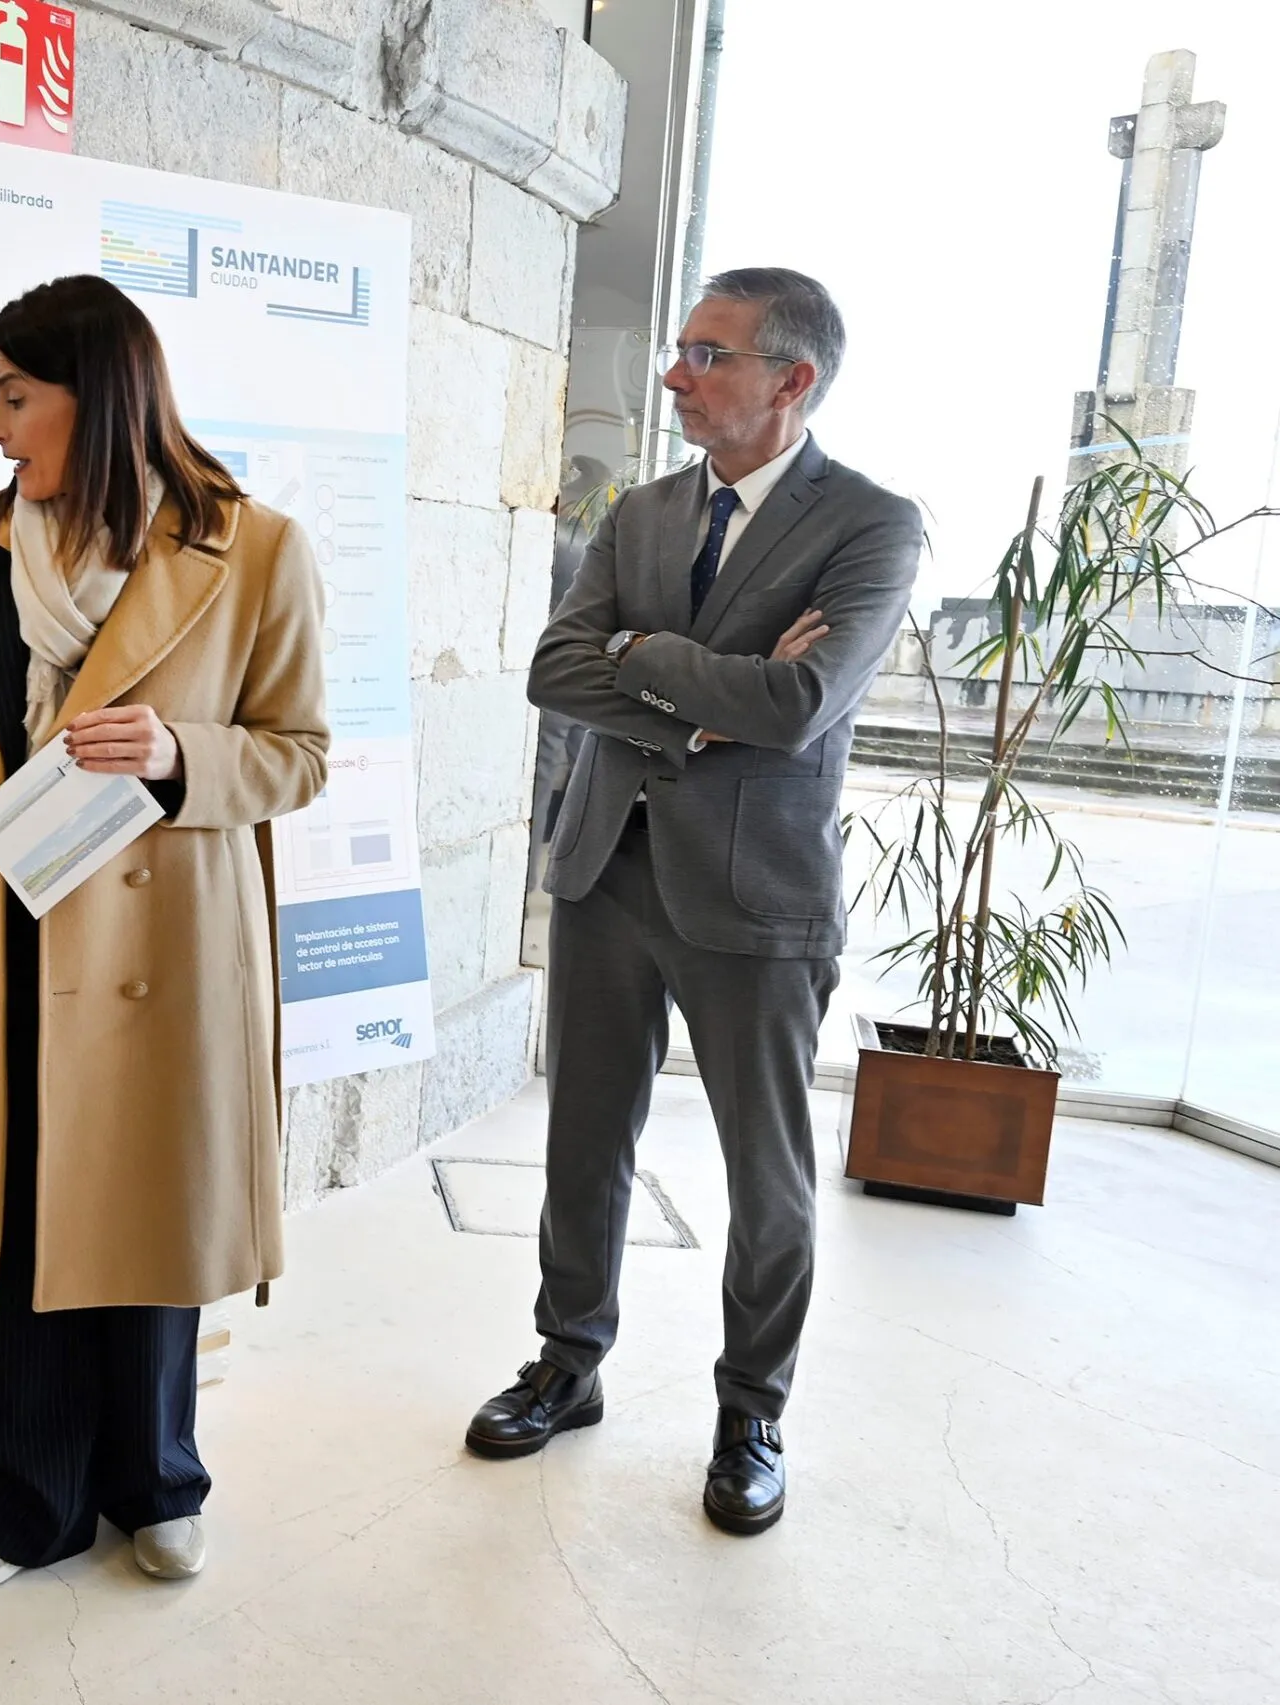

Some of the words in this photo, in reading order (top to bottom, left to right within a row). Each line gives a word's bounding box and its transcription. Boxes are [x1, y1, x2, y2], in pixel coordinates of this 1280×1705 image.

[212, 247, 339, 284] SANTANDER
[211, 272, 258, 289] CIUDAD
[295, 927, 352, 943] Implantación
[354, 924, 365, 934] de
[366, 922, 399, 933] sistema
[296, 948, 308, 957] de
[310, 942, 340, 956] control
[342, 941, 353, 951] de
[354, 938, 383, 949] acceso
[384, 936, 400, 944] con
[298, 962, 323, 972] lector
[325, 958, 336, 968] de
[356, 1018, 404, 1041] senor
